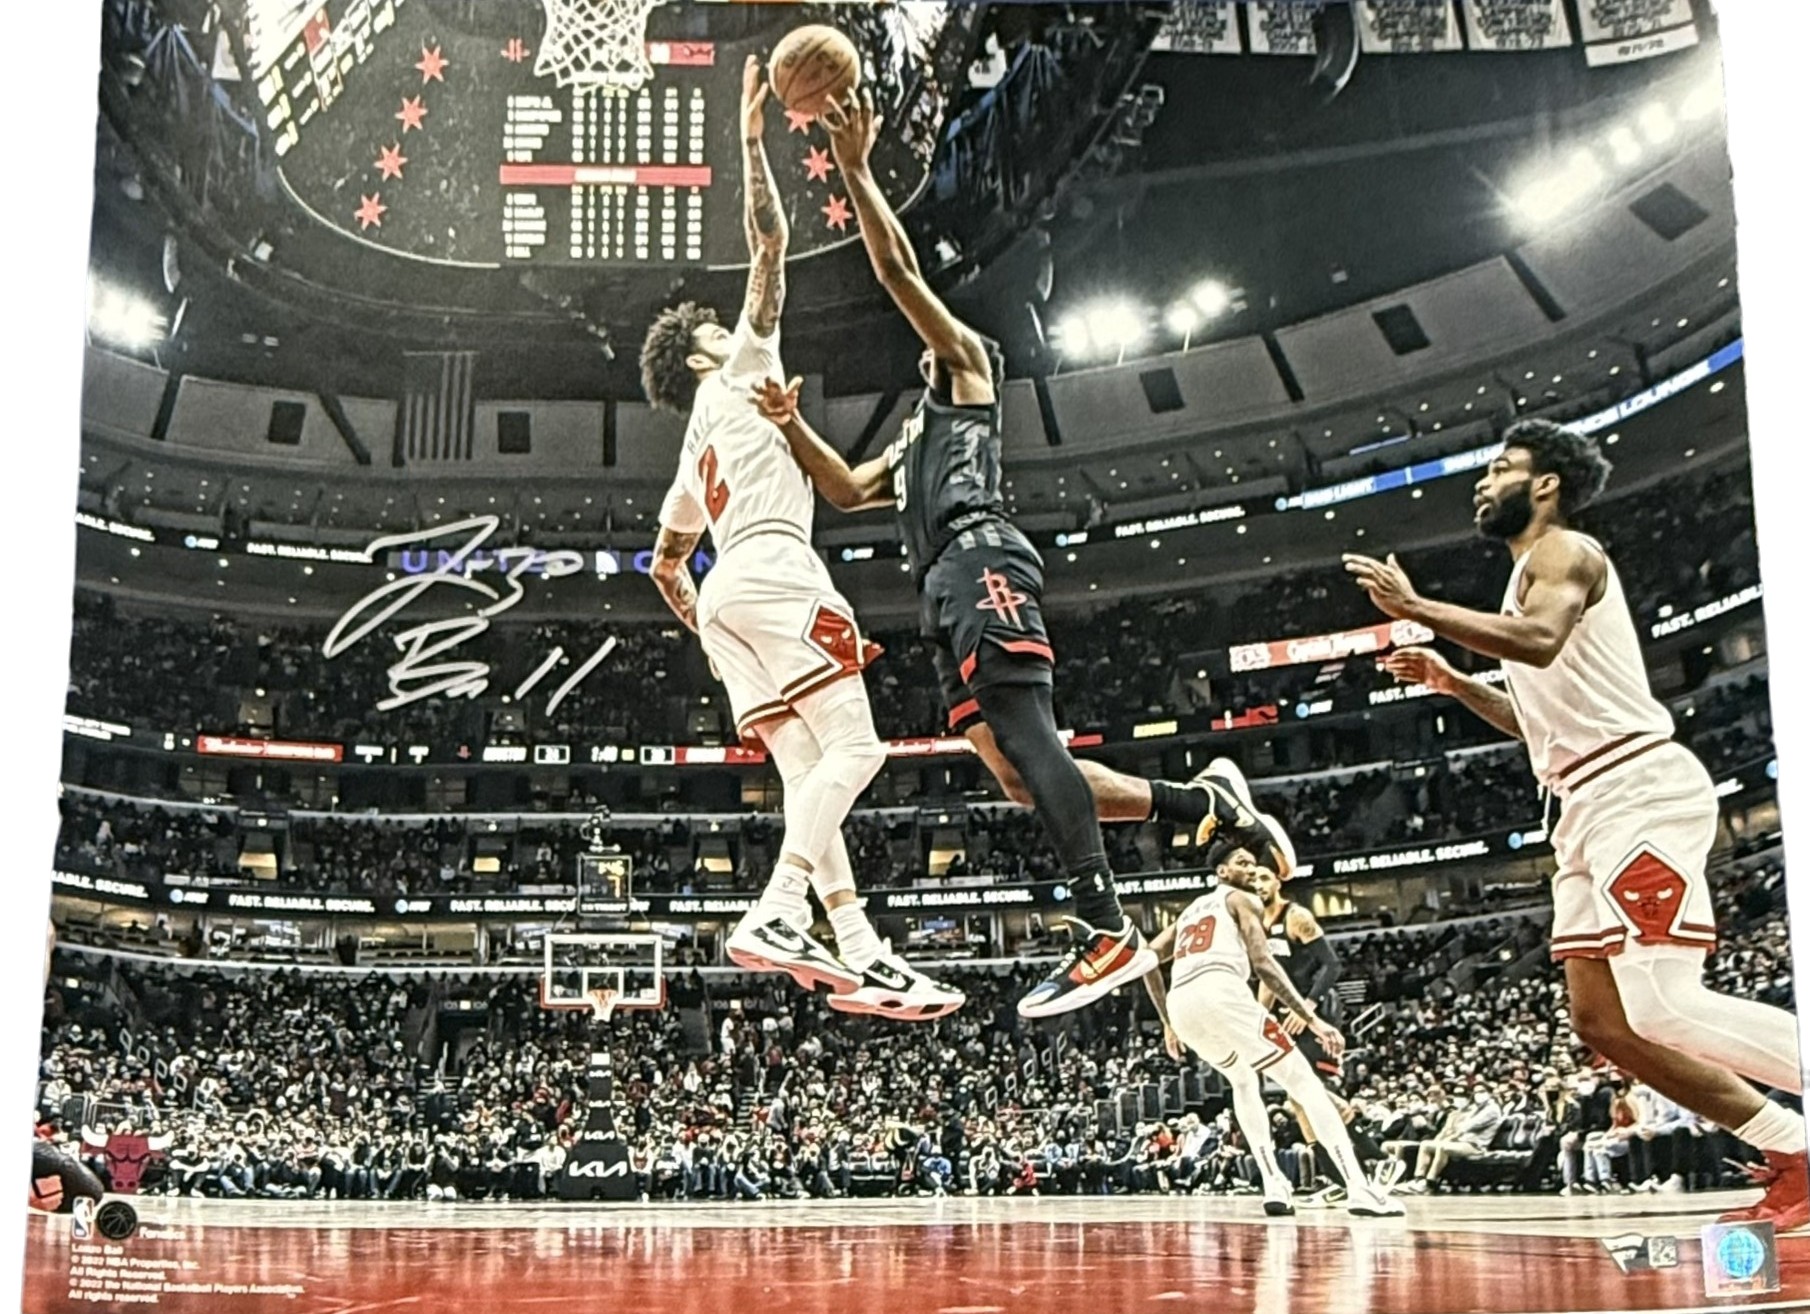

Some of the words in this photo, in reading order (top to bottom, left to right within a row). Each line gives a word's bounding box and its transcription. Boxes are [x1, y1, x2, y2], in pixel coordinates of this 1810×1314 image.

[698, 443, 730, 525] 2
[1333, 857, 1369, 873] FAST.
[229, 894, 262, 907] FAST.
[450, 900, 483, 912] FAST.
[669, 900, 702, 912] FAST.
[887, 894, 921, 908] FAST.
[1175, 914, 1217, 960] 28
